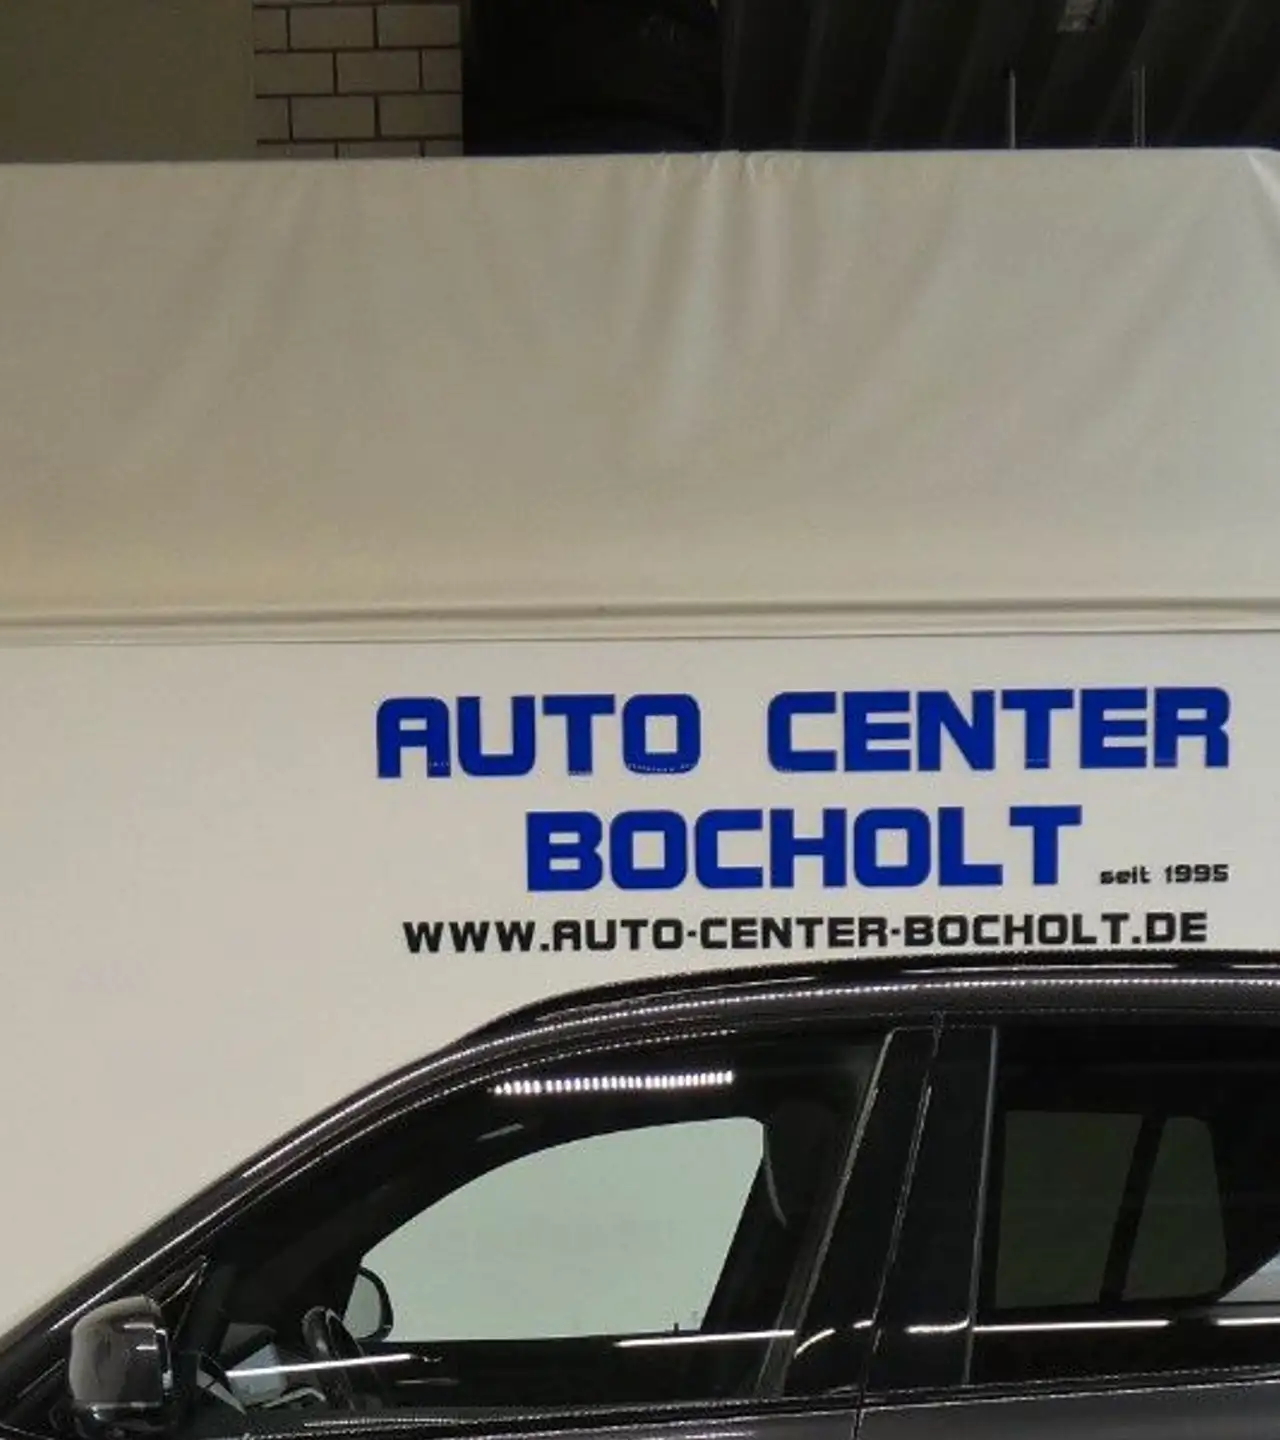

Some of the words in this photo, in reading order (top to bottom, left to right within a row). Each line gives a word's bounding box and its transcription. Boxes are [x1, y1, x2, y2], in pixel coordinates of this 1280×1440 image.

[377, 695, 702, 779] AUTO
[768, 686, 1230, 773] CENTER
[526, 804, 1082, 892] BOCHOLT
[1100, 864, 1152, 885] seit
[1164, 863, 1230, 884] 1995
[402, 911, 1208, 954] WWW.AUTO-CENTER-BOCHOLT.DE
